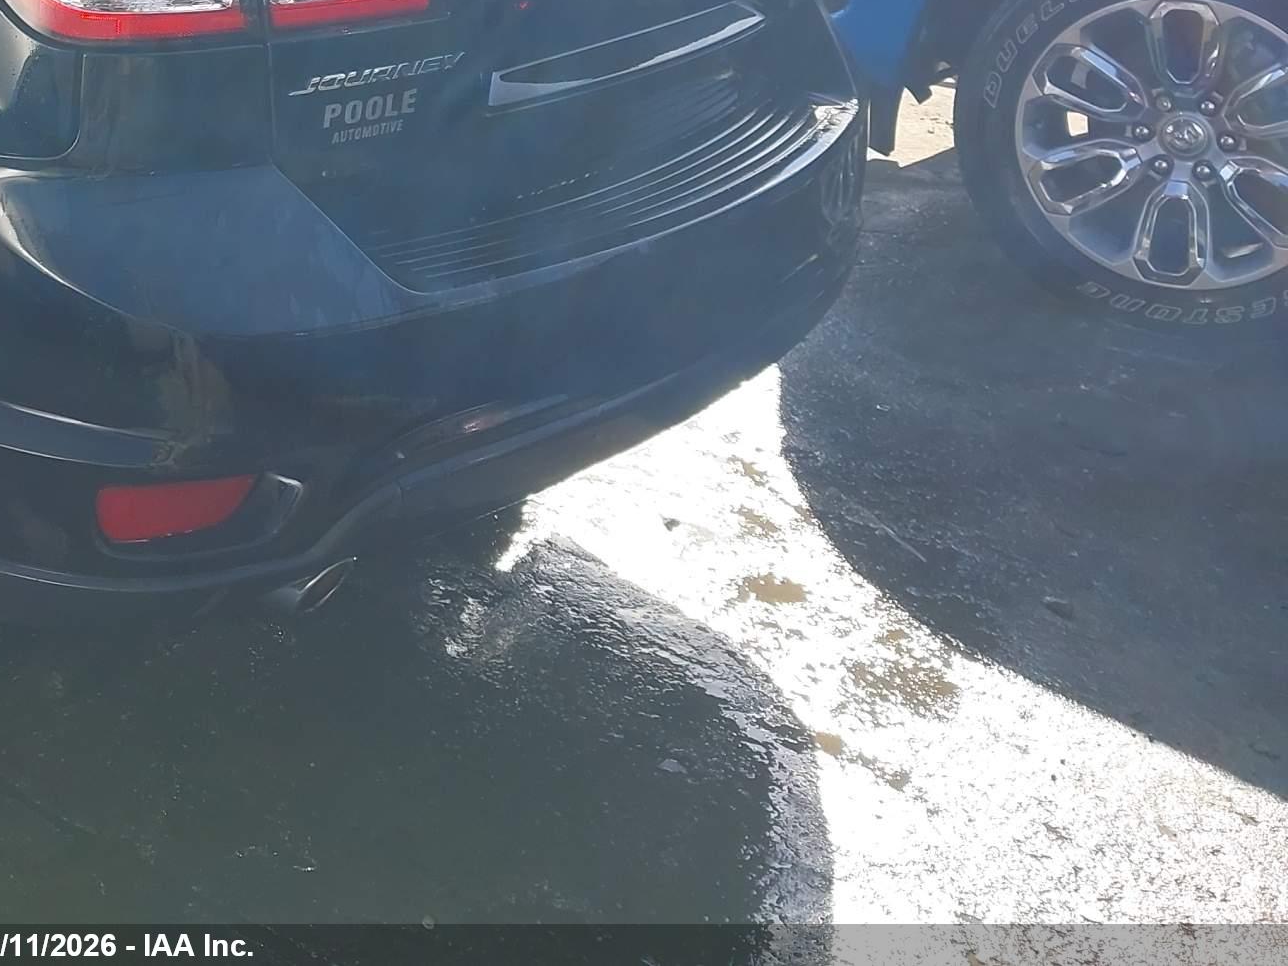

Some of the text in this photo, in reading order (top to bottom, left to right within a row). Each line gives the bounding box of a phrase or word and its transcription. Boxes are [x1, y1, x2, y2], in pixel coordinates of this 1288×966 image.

[288, 51, 465, 96] JOURNEY
[323, 88, 418, 129] POOLE
[331, 119, 404, 144] AUTOMOTIVE
[1076, 281, 1288, 324] ESTONE
